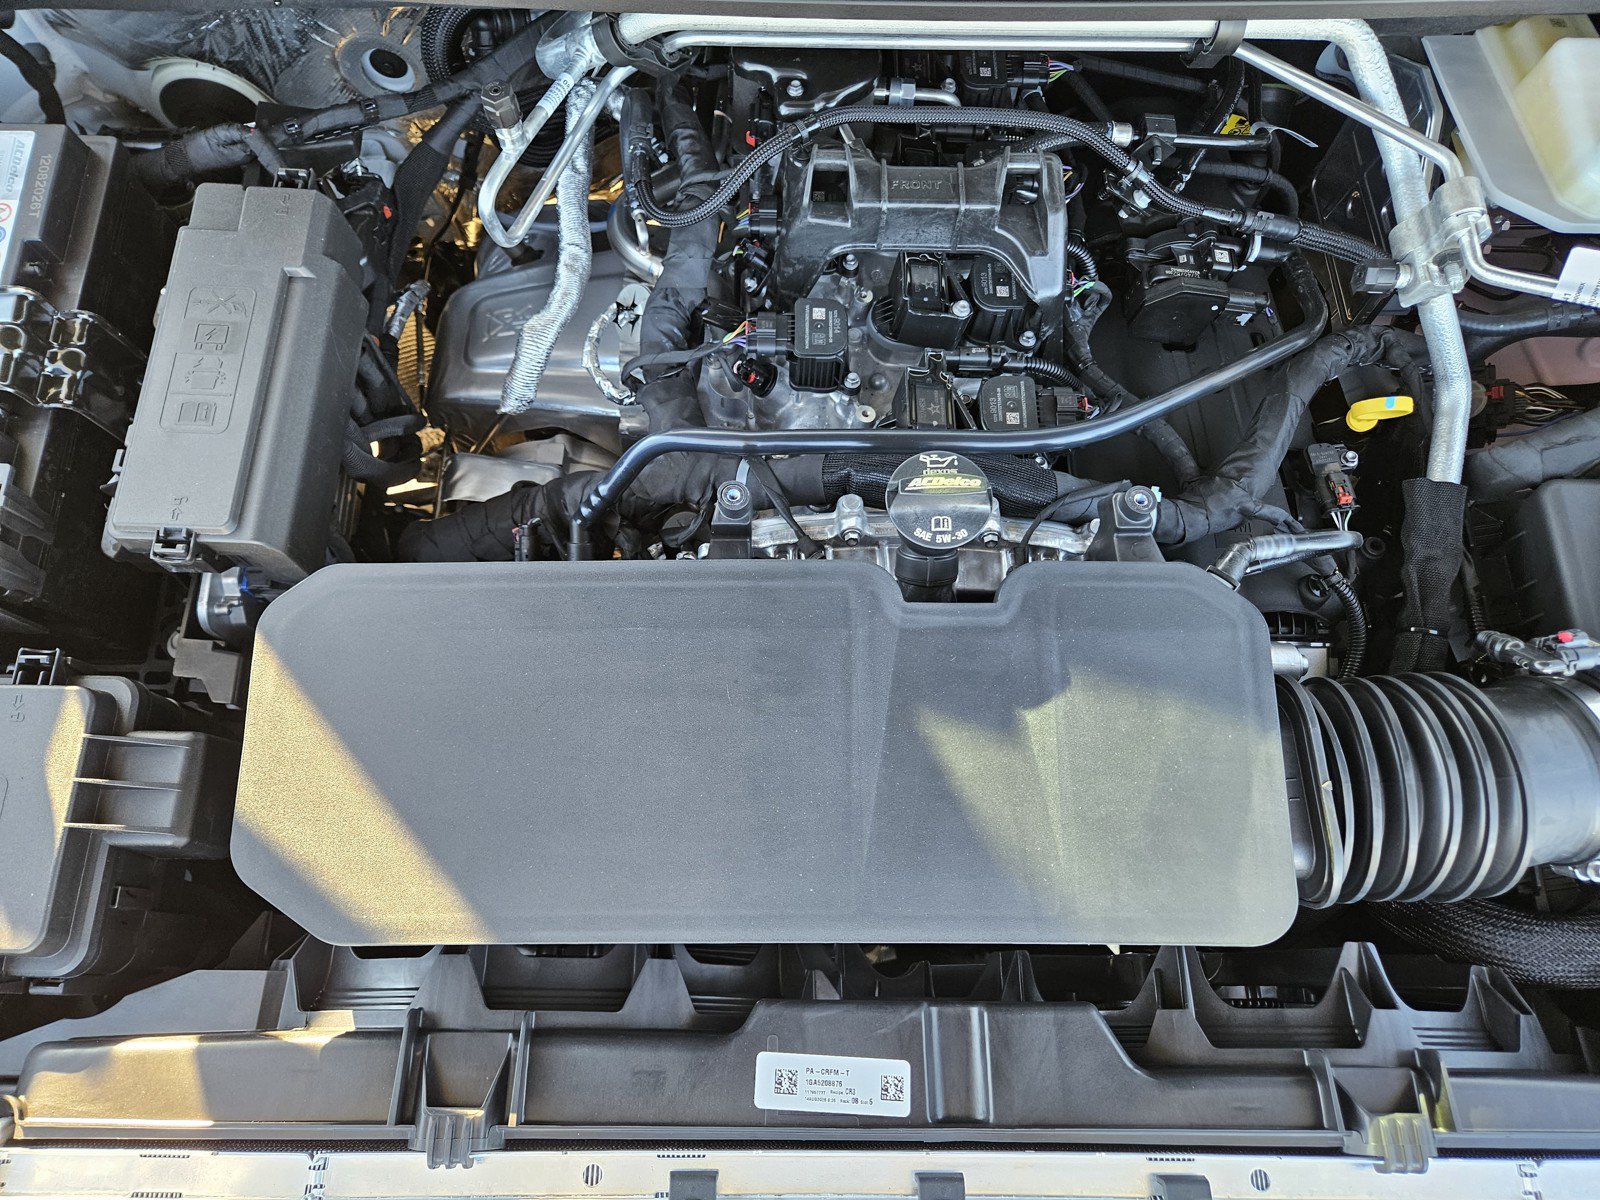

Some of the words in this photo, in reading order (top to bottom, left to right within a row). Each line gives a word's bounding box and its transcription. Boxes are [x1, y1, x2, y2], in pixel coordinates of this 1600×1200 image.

[28, 153, 52, 218] 12082026T
[891, 180, 943, 190] FRONT
[904, 476, 982, 490] ACDelco
[913, 527, 933, 542] SAE
[935, 528, 968, 544] 5W-30
